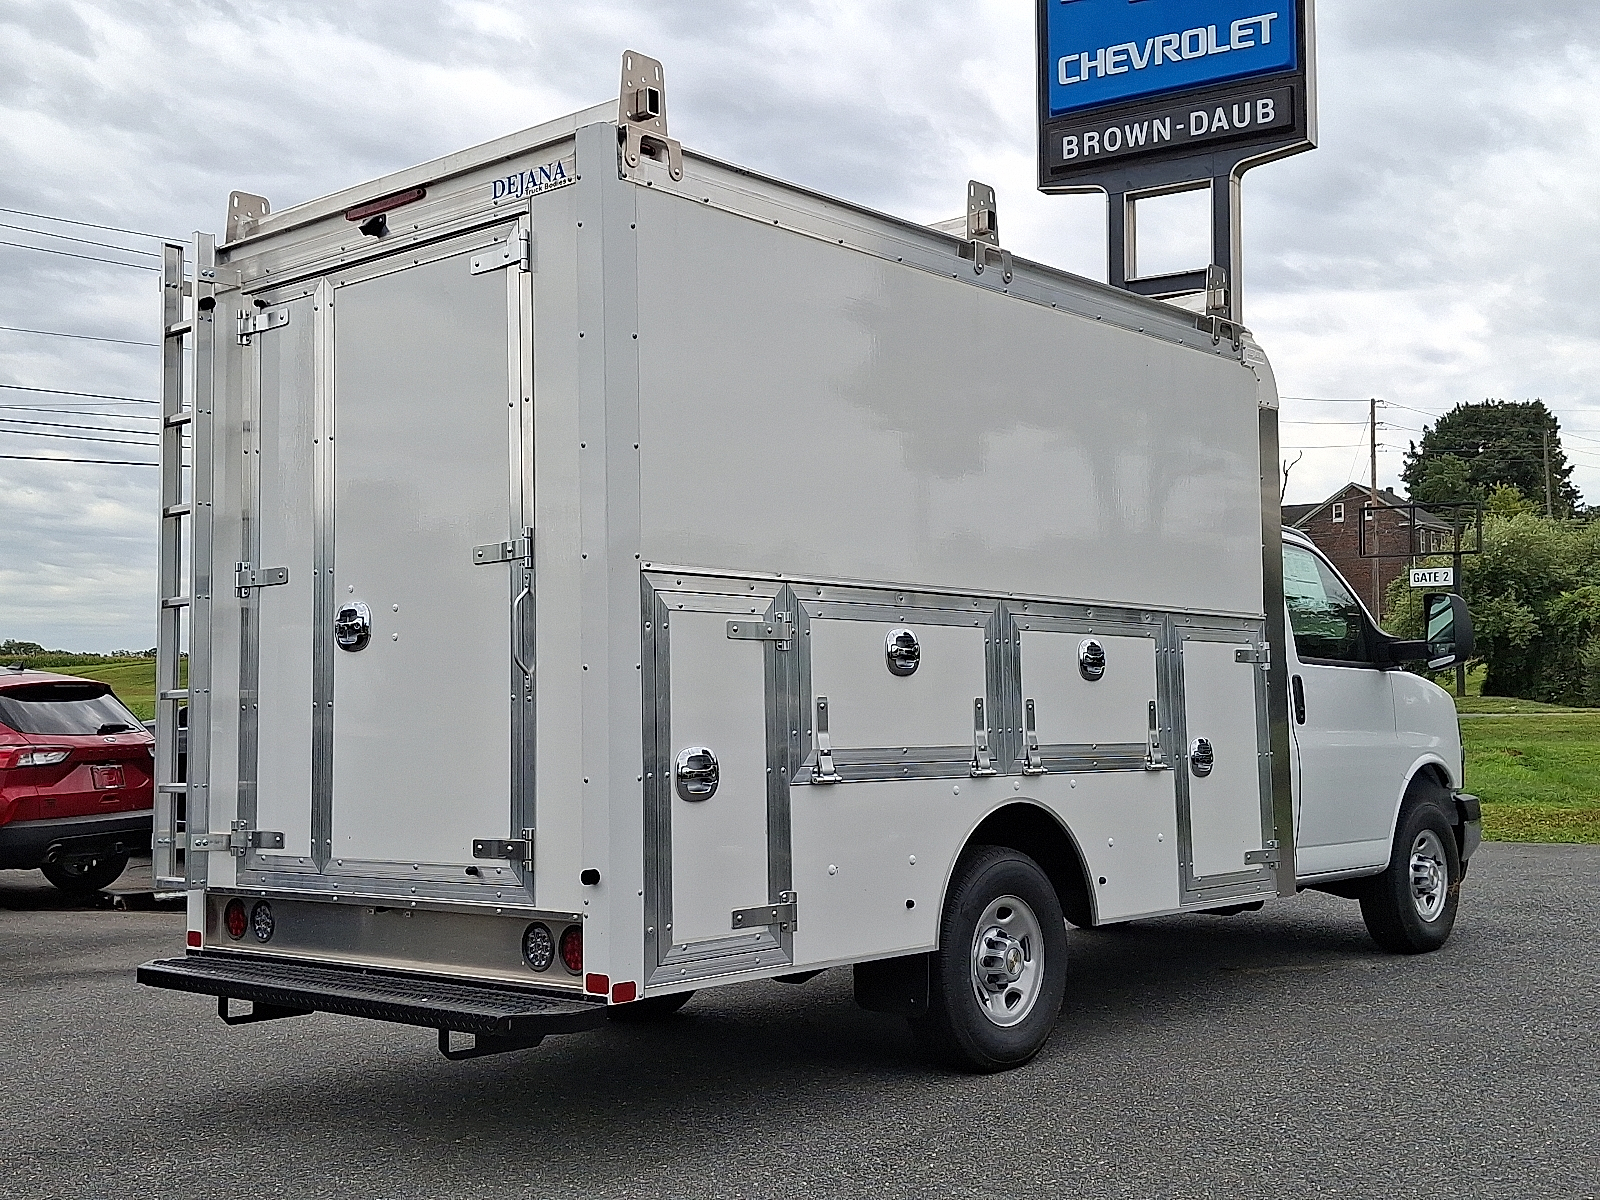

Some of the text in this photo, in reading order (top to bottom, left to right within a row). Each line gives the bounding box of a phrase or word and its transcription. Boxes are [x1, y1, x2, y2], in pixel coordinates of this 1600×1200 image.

[1058, 12, 1278, 85] CHEVROLET
[1062, 98, 1276, 160] BROWN-DAUB
[492, 160, 567, 199] DEJANA
[525, 178, 567, 196] Truck Bodies
[1413, 571, 1449, 582] GATE 2
